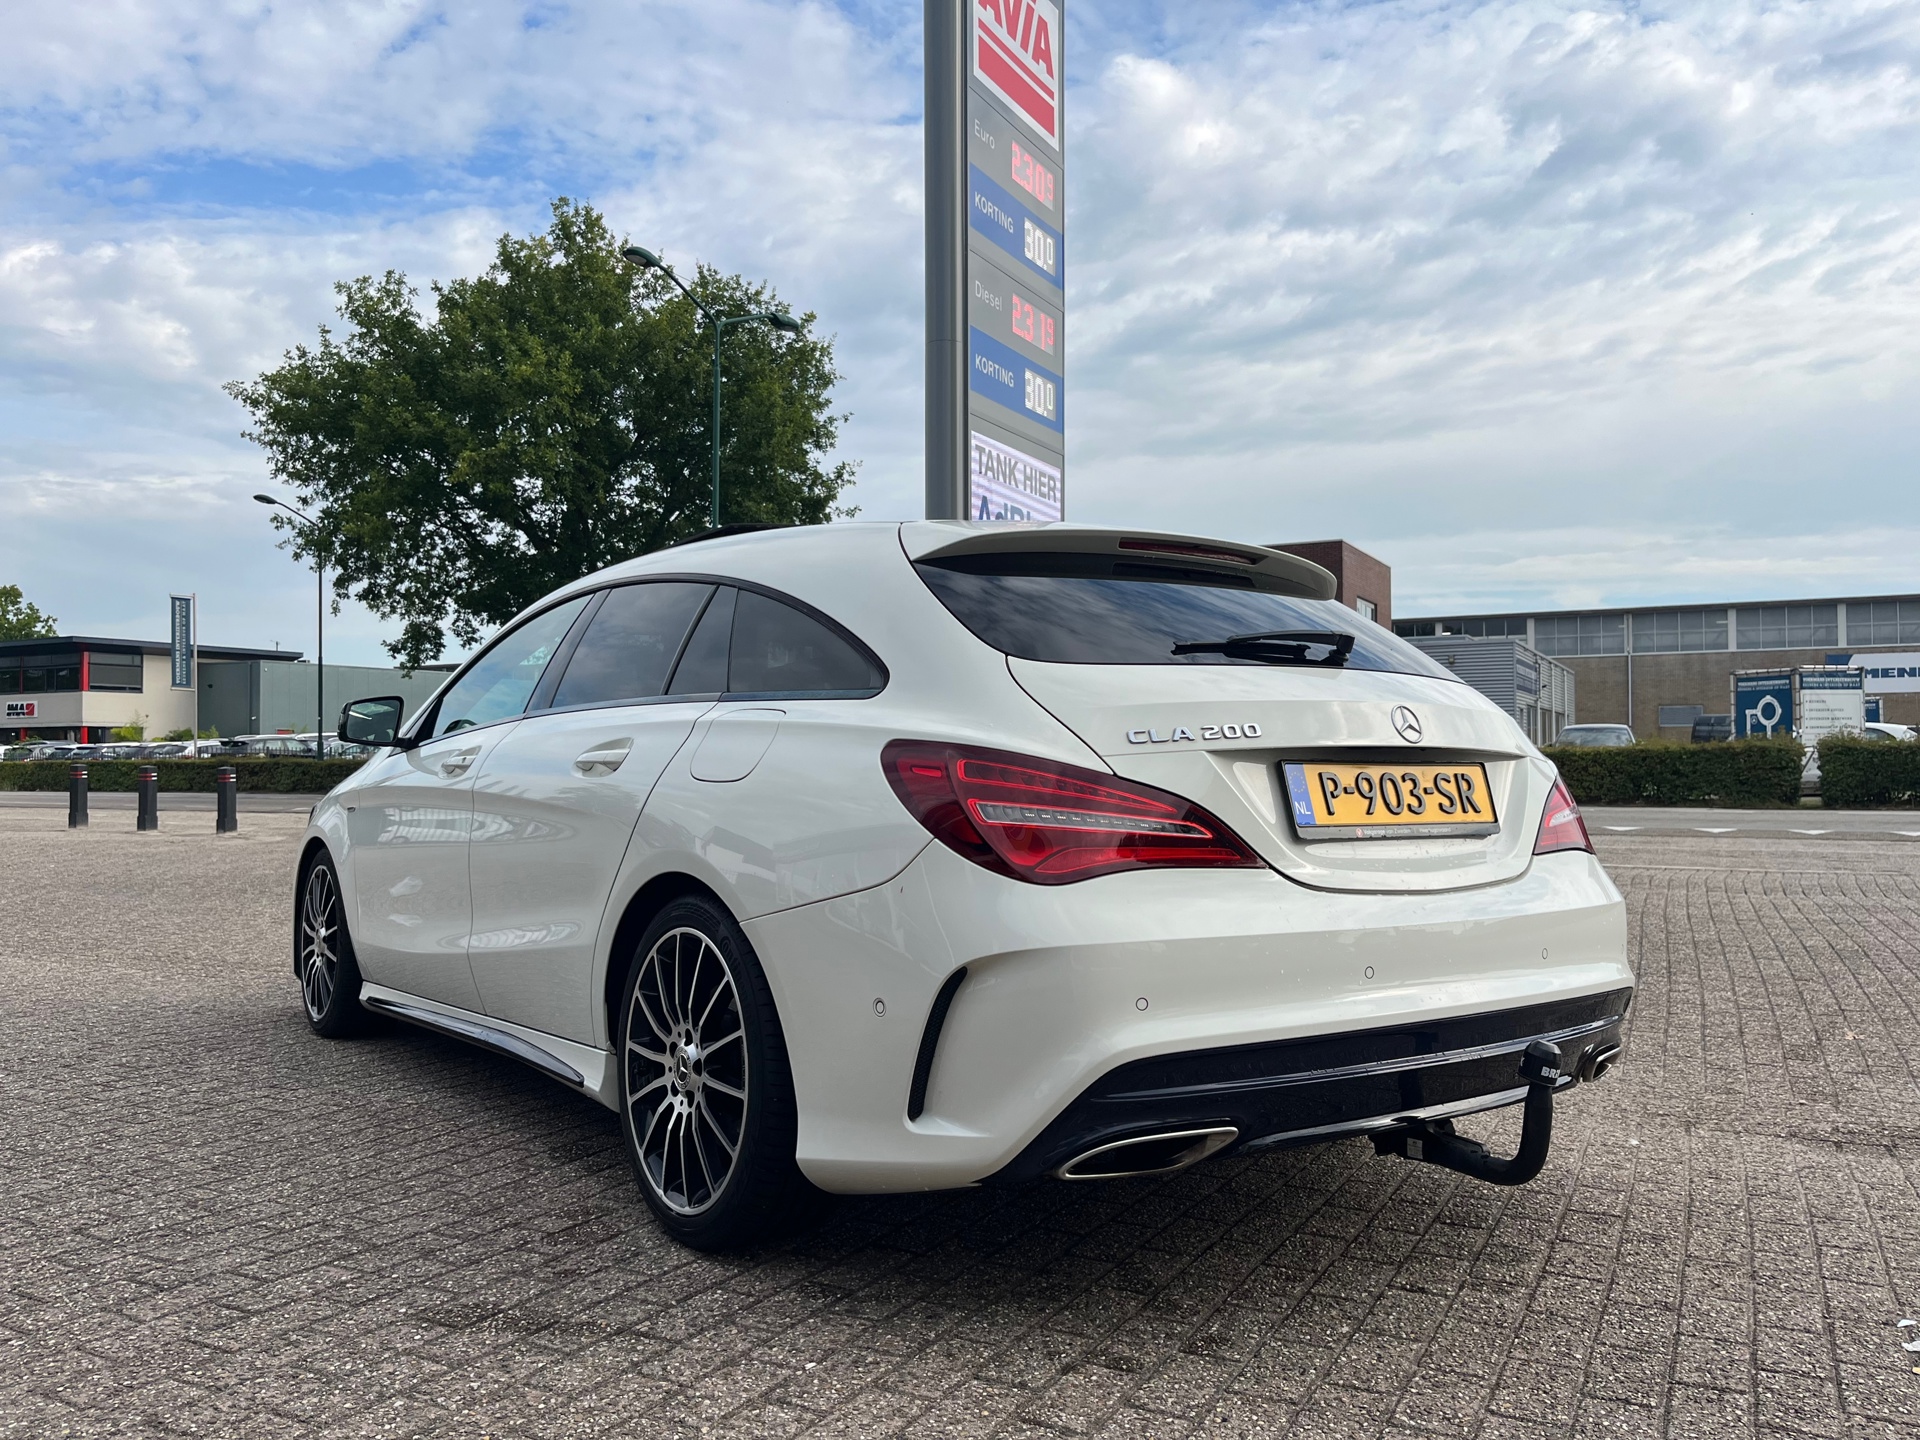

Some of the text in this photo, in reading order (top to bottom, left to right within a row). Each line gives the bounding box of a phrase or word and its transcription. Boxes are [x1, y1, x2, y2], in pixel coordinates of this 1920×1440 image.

[975, 118, 995, 150] Euro
[974, 191, 1014, 234] KORTING
[975, 279, 1003, 312] Diesel
[975, 353, 1015, 388] KORTING
[975, 443, 1057, 503] TANK HIER
[1125, 722, 1262, 745] CLA 200
[1294, 800, 1311, 815] NL
[1318, 771, 1482, 816] P-903-SR
